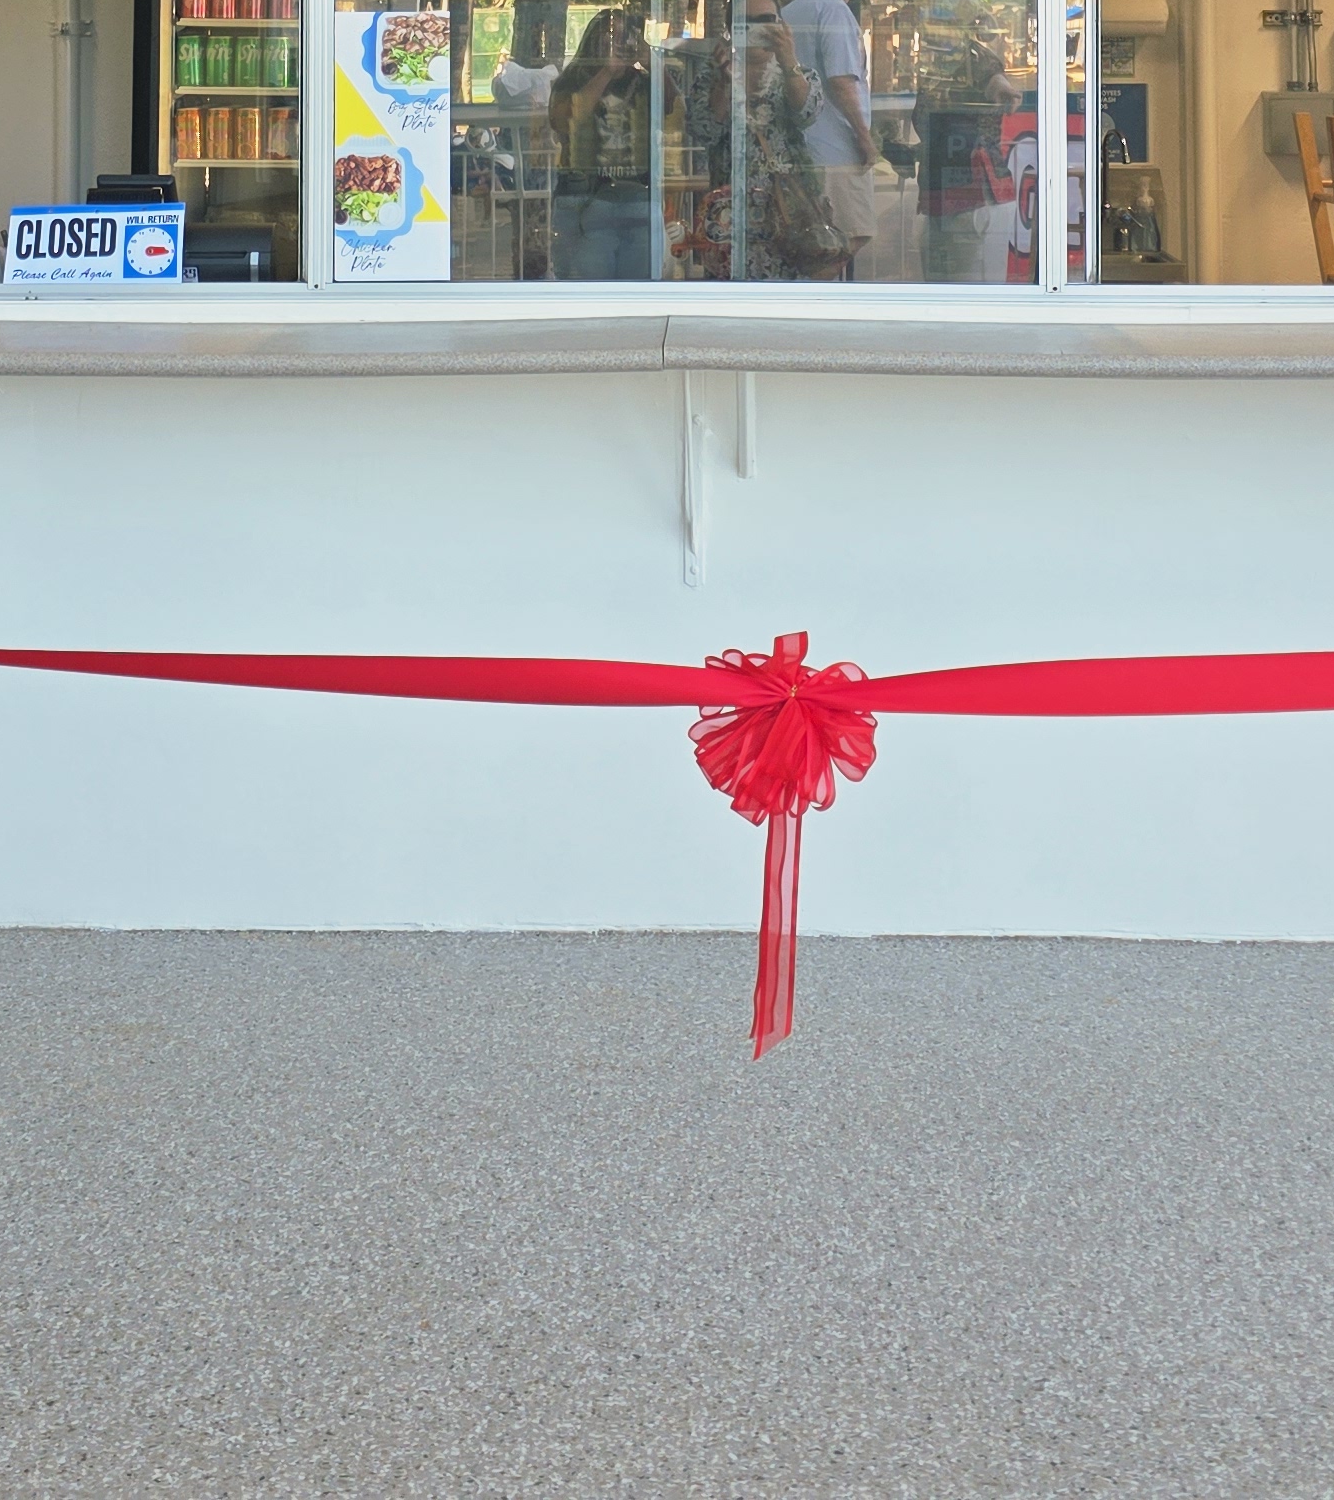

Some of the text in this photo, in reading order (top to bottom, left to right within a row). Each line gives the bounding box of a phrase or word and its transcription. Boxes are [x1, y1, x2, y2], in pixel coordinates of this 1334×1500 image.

[127, 215, 179, 224] WILL RETURN
[15, 218, 118, 259] CLOSED
[341, 239, 395, 257] Chicken
[12, 268, 112, 281] Please Call Again
[351, 256, 386, 275] Plate
